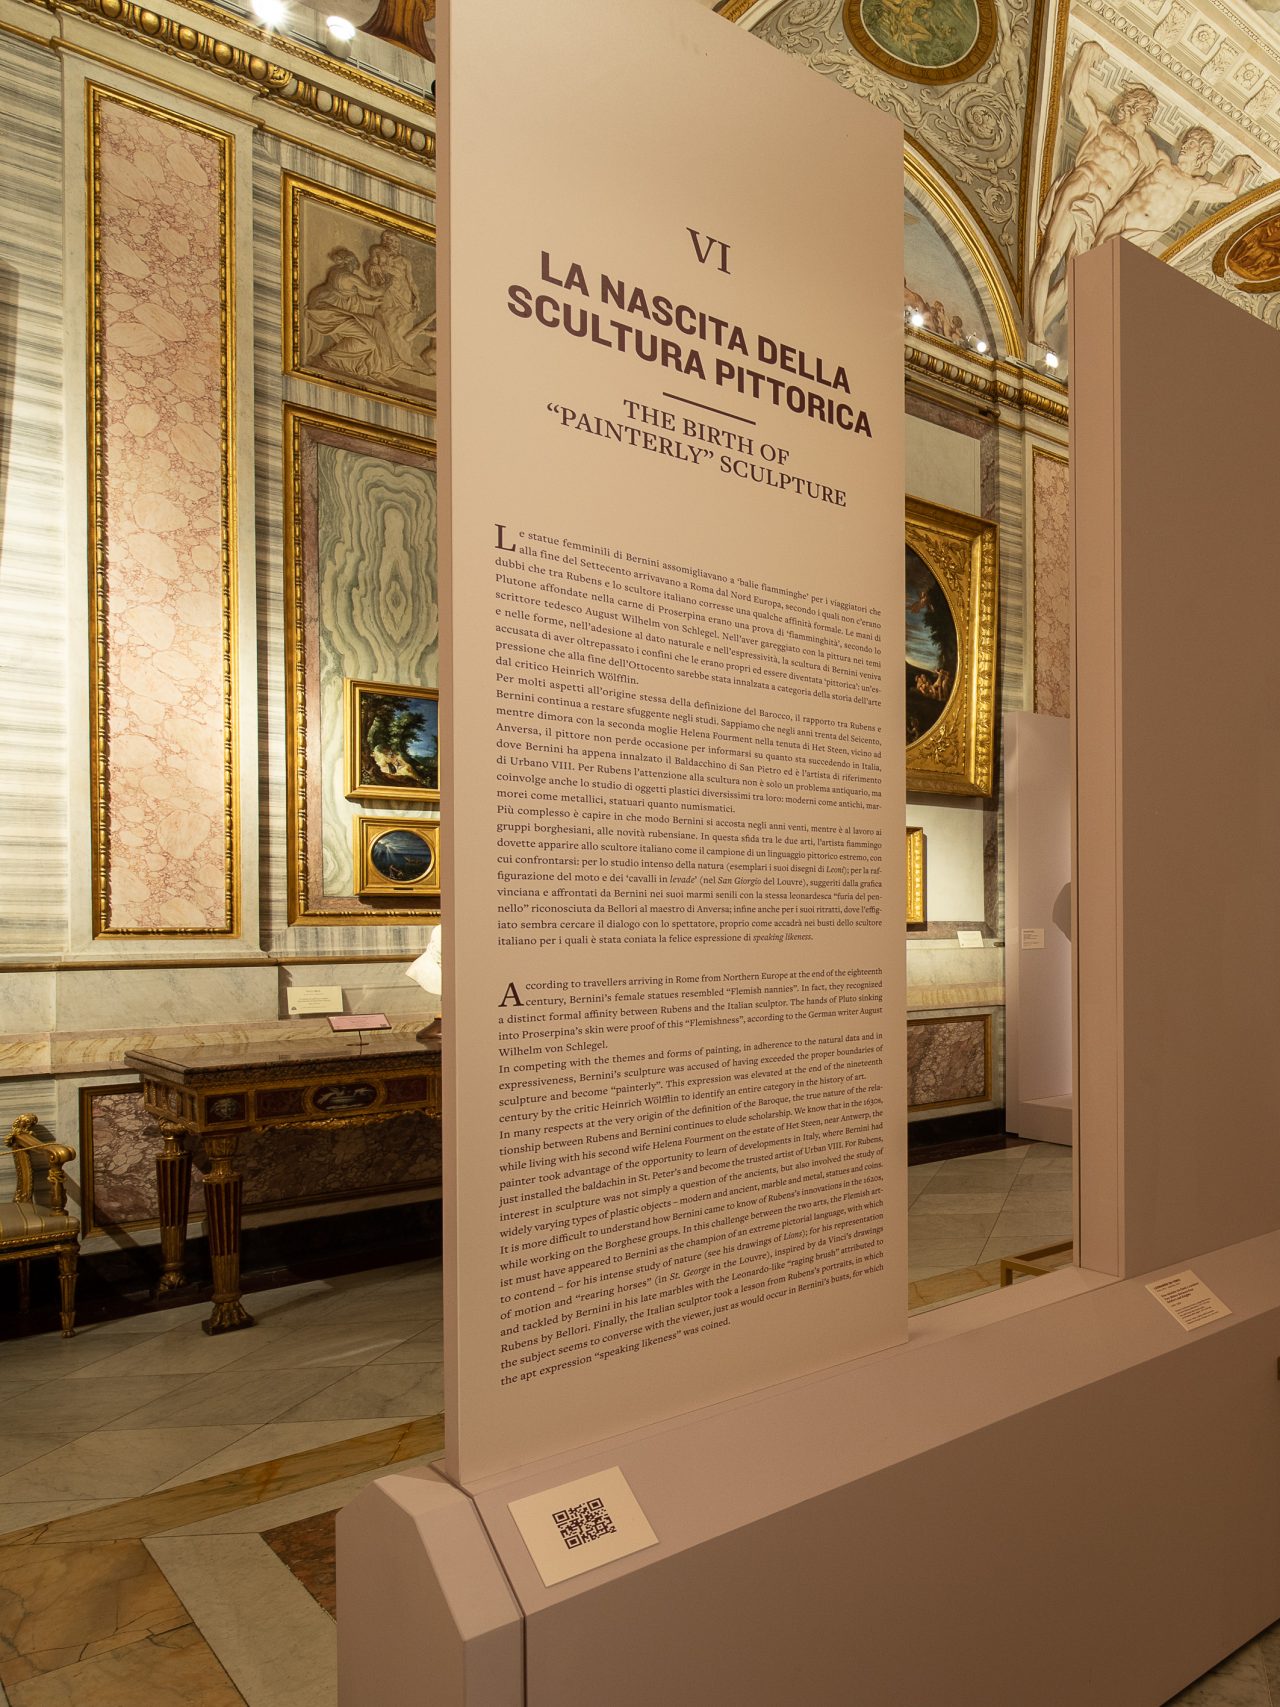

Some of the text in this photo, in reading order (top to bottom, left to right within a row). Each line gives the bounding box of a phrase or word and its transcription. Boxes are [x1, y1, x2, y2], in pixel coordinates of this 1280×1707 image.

[686, 226, 732, 275] VI
[541, 250, 851, 394] LA NASCITA DELLA
[507, 284, 873, 438] SCULTURA PITTORICA
[546, 402, 847, 508] “PAINTERLY” SCULPTURE
[622, 399, 790, 466] THE BIRTH OF
[527, 532, 560, 546] statue
[562, 537, 611, 557] femminili
[612, 549, 623, 560] di
[625, 552, 660, 568] Bernini
[661, 562, 728, 583] assomigliavano
[729, 577, 735, 585] a
[810, 595, 824, 604] per
[829, 599, 868, 614] viaggiatori
[868, 606, 882, 617] che
[495, 591, 541, 606] scrittore
[543, 599, 583, 614] tedesco
[584, 606, 618, 621] August
[620, 612, 661, 628] Wilhelm
[661, 621, 680, 632] von
[681, 624, 720, 639] Schlegel.
[759, 640, 801, 653] gareggiato
[801, 648, 816, 657] con
[817, 648, 825, 658] la
[825, 651, 852, 663] pittura
[852, 657, 864, 665] nei
[864, 659, 882, 668] temi
[495, 655, 512, 667] dal
[513, 659, 549, 672] critico
[551, 663, 596, 679] Heinrich
[495, 672, 515, 683] Per
[517, 677, 546, 688] molti
[549, 681, 585, 693] aspetti
[638, 693, 667, 704] stessa
[668, 695, 691, 707] della
[693, 699, 742, 714] definizione
[743, 706, 757, 716] del
[758, 708, 793, 722] Barocco,
[794, 713, 801, 722] il
[802, 716, 836, 727] rapporto
[836, 720, 848, 728] tra
[849, 721, 876, 732] Rubens
[496, 789, 736, 813] morei come metallici, statuari quanto numismatici.
[495, 822, 531, 834] gruppi
[533, 822, 595, 836] borghesiani,
[596, 826, 614, 836] alle
[616, 827, 646, 838] novità
[647, 828, 698, 840] rubensiane.
[700, 831, 710, 841] In
[711, 834, 740, 844] questa
[740, 833, 760, 843] sfida
[761, 836, 774, 844] tra
[774, 835, 783, 844] le
[783, 835, 798, 845] due
[799, 837, 816, 847] arti,
[845, 839, 883, 851] fiammingo
[497, 935, 537, 946] italiano
[538, 937, 557, 948] per
[563, 934, 588, 947] quali
[590, 935, 597, 944] è
[598, 936, 622, 944] stata
[623, 934, 657, 944] coniata
[658, 933, 667, 943] la
[668, 933, 692, 943] felice
[693, 933, 742, 945] espressione
[742, 932, 752, 942] di
[752, 932, 785, 944] speaking
[784, 932, 814, 941] likeness.
[497, 993, 883, 1025] a distinct formal affinity between Rubens and the Italian sculptor. The hands of Pluto sinking
[497, 1039, 608, 1057] Wilhelm von Schlegel.
[498, 1111, 539, 1123] century
[540, 1108, 554, 1120] by
[554, 1106, 572, 1116] the
[573, 1103, 600, 1114] critic
[601, 1097, 642, 1111] Heinrich
[680, 1093, 691, 1102] to
[691, 1088, 725, 1100] identify
[725, 1088, 737, 1096] an
[737, 1084, 762, 1095] entire
[762, 1081, 796, 1092] category
[796, 1079, 805, 1088] in
[805, 1077, 819, 1087] the
[818, 1075, 845, 1085] history
[845, 1072, 854, 1082] of
[853, 1073, 867, 1081] art.
[499, 1323, 520, 1337] and
[521, 1313, 559, 1332] tackled
[560, 1312, 574, 1323] by
[575, 1301, 611, 1319] Bernini
[612, 1300, 623, 1310] in
[623, 1296, 639, 1307] his
[639, 1292, 657, 1303] late
[658, 1283, 694, 1298] marbles
[694, 1277, 715, 1289] with
[715, 1274, 730, 1285] the
[731, 1261, 786, 1281] Leonardo-like
[840, 1238, 876, 1255] attributed
[875, 1238, 884, 1246] to
[500, 1375, 518, 1386] the
[519, 1369, 537, 1382] apt
[538, 1355, 592, 1376] expression
[682, 1326, 699, 1336] was
[700, 1316, 731, 1332] coined.
